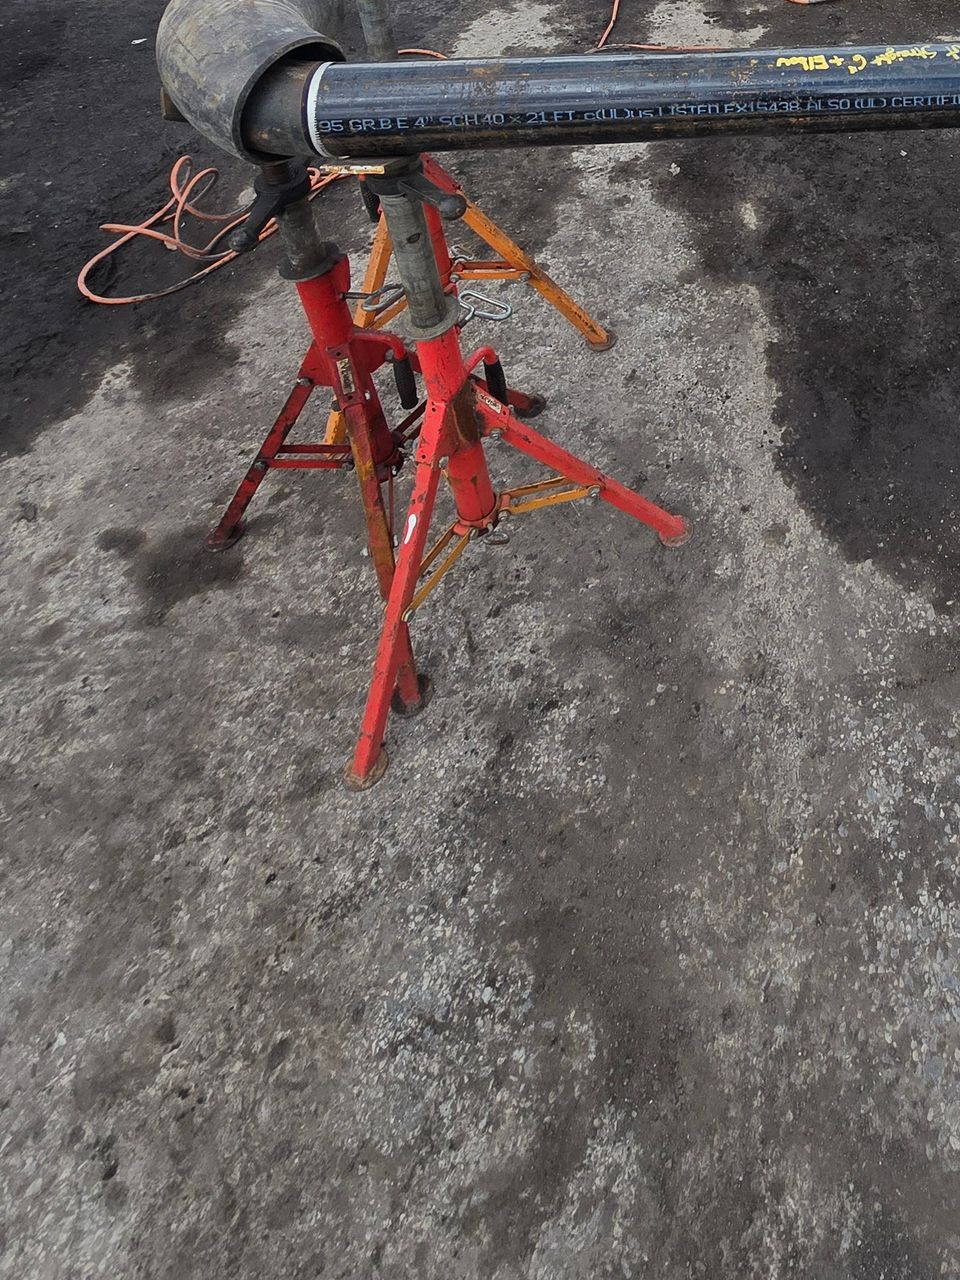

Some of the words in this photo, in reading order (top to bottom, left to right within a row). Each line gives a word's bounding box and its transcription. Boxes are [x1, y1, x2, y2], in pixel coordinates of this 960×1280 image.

[776, 54, 829, 71] Elbow
[526, 111, 549, 125] 21
[554, 110, 575, 122] FT
